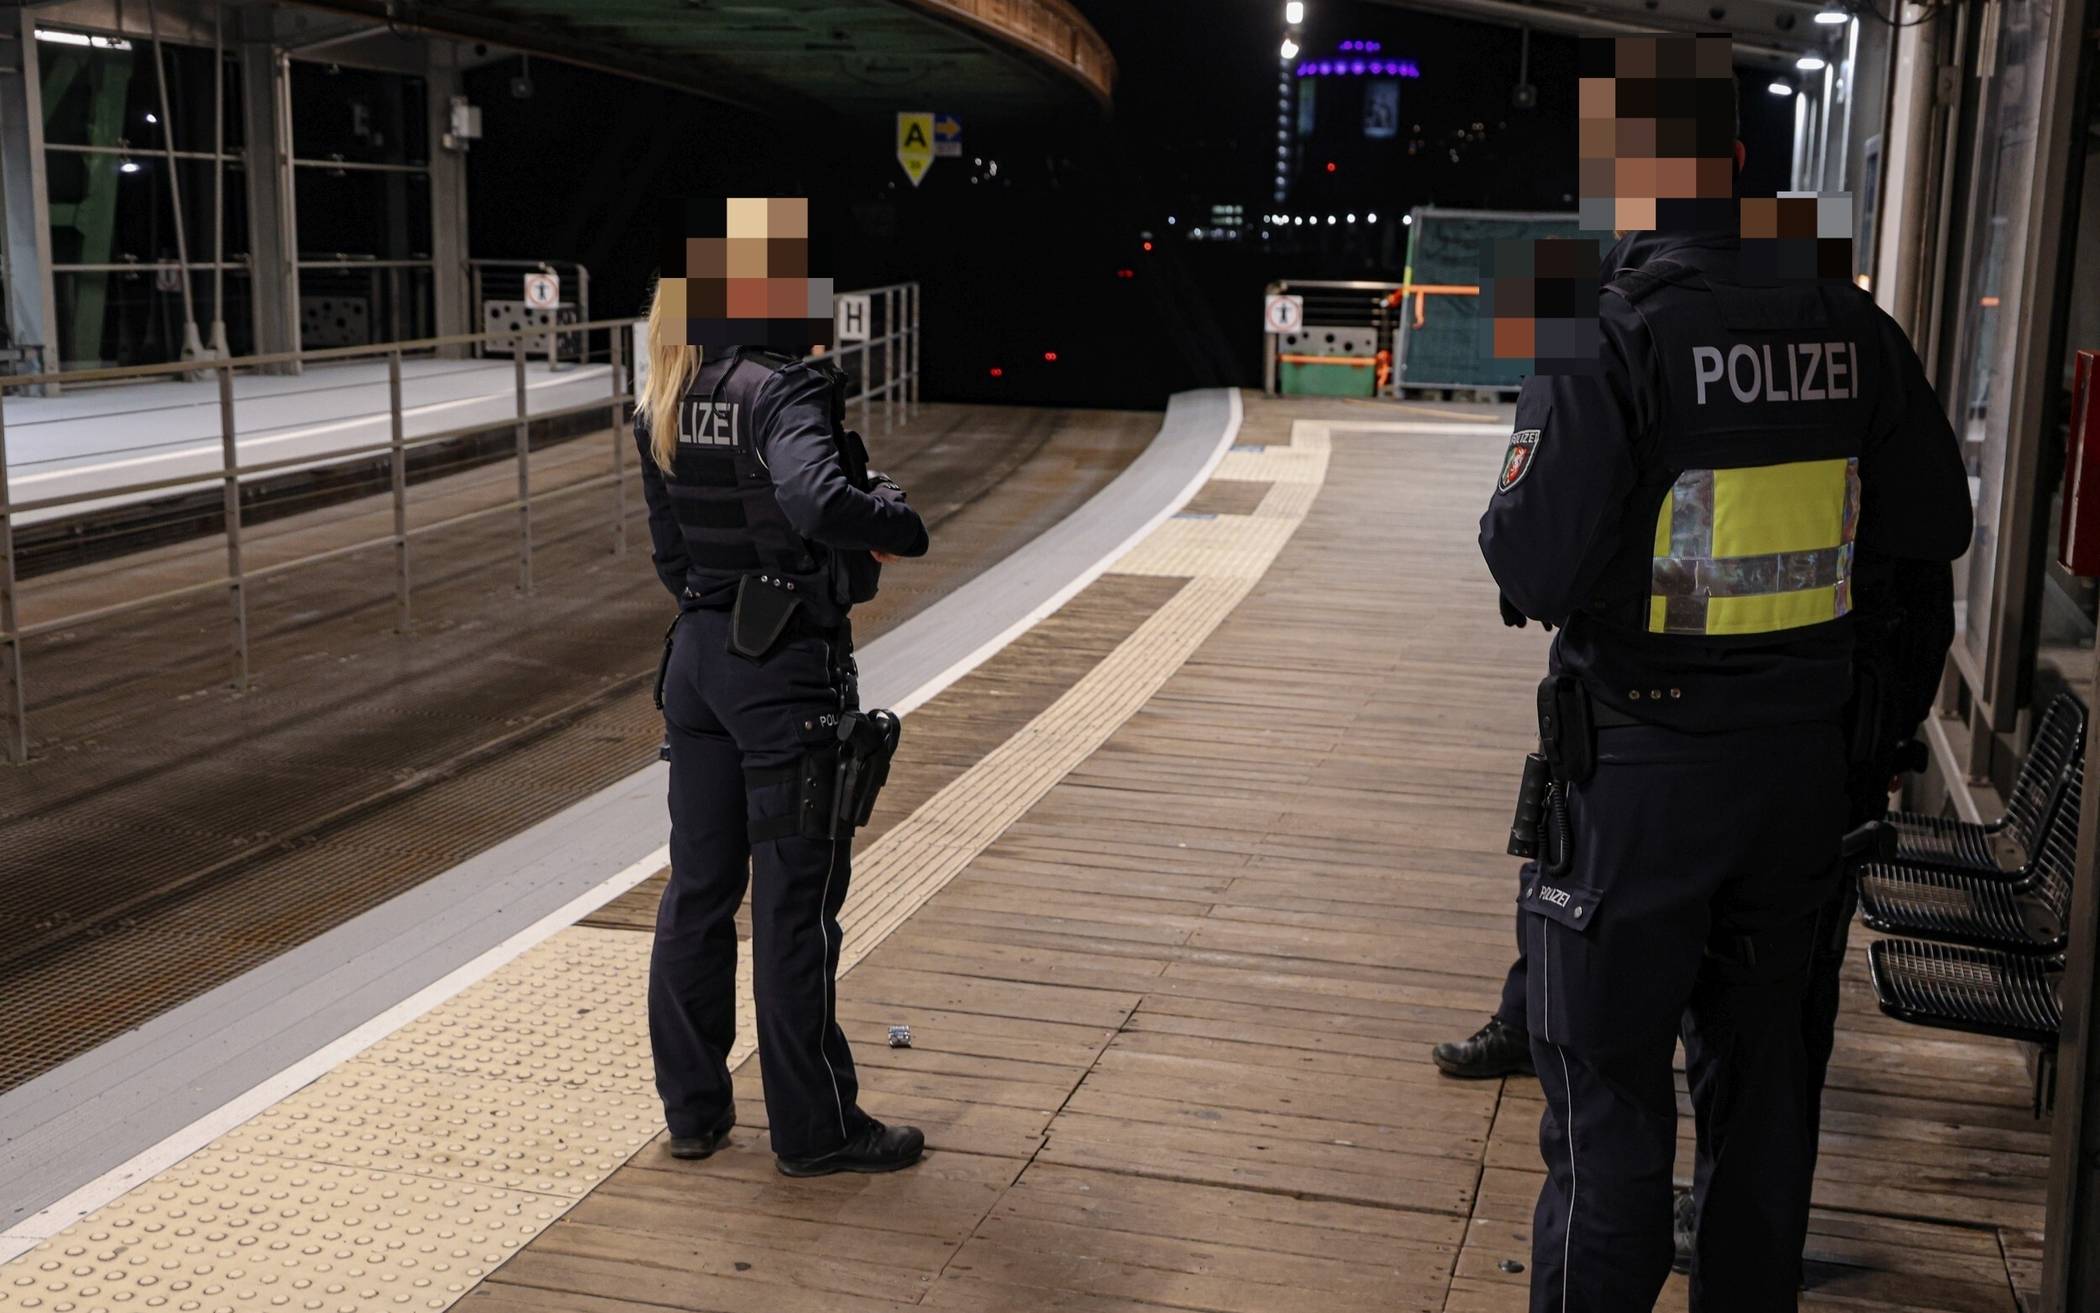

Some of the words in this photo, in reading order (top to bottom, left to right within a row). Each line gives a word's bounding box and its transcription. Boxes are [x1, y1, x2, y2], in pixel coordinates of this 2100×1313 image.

[904, 122, 927, 147] A
[846, 301, 863, 333] H
[1692, 342, 1858, 404] POLIZEI
[678, 401, 740, 446] LIZEI
[1540, 886, 1570, 907] POLIZEI
